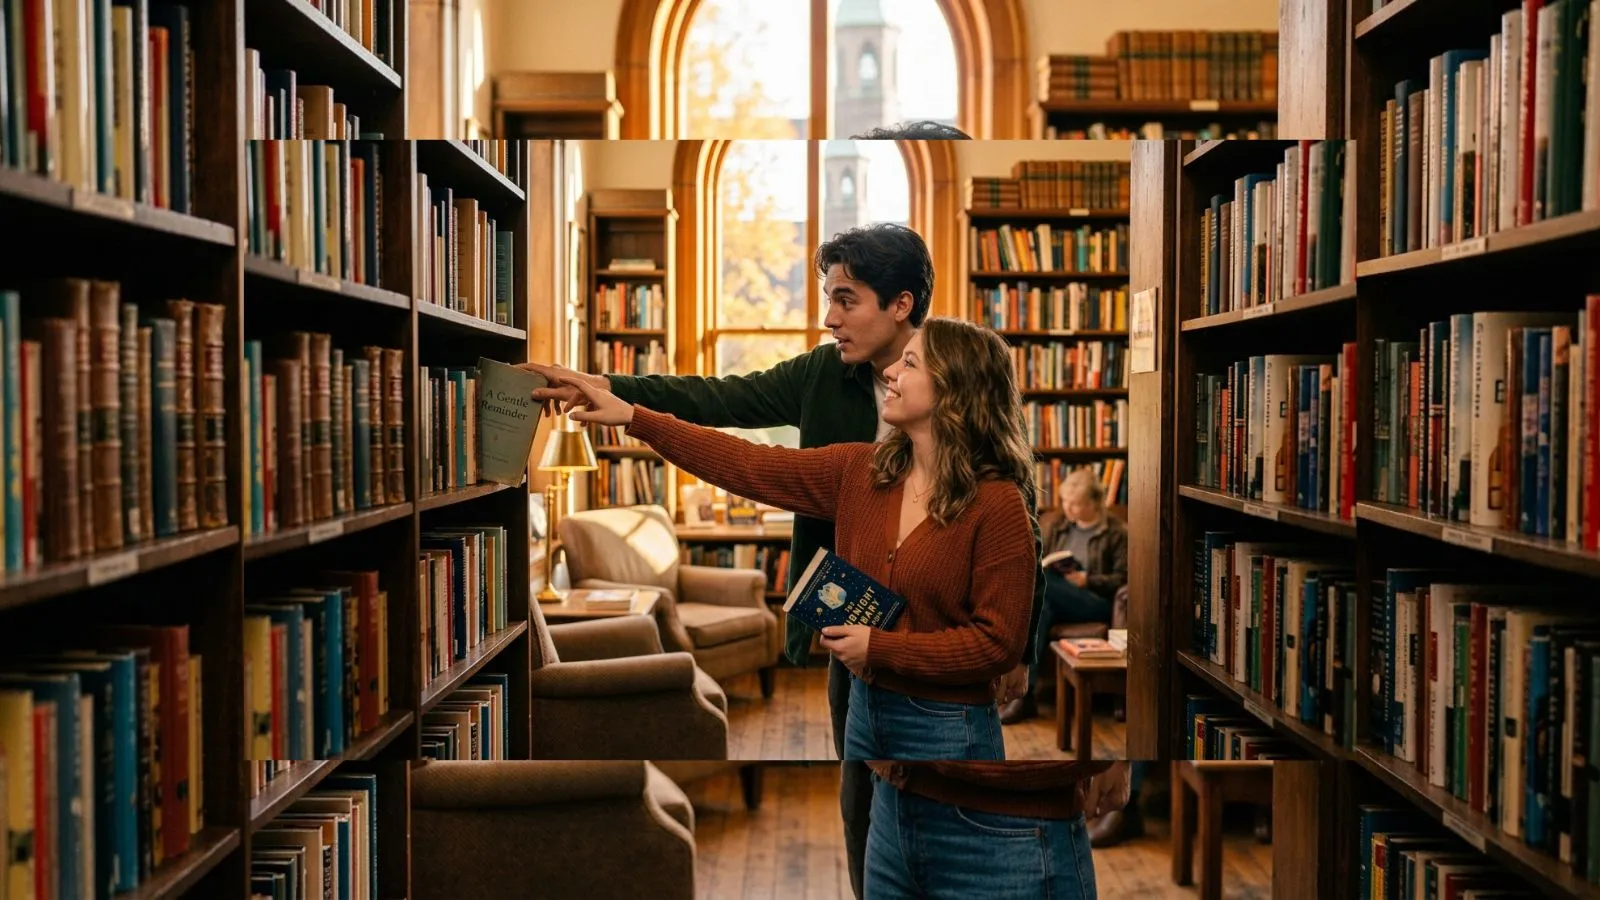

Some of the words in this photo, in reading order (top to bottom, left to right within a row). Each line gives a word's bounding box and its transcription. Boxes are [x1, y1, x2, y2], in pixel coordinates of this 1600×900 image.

[486, 389, 494, 398] A
[497, 391, 529, 408] Gentle
[480, 400, 529, 421] Reminder
